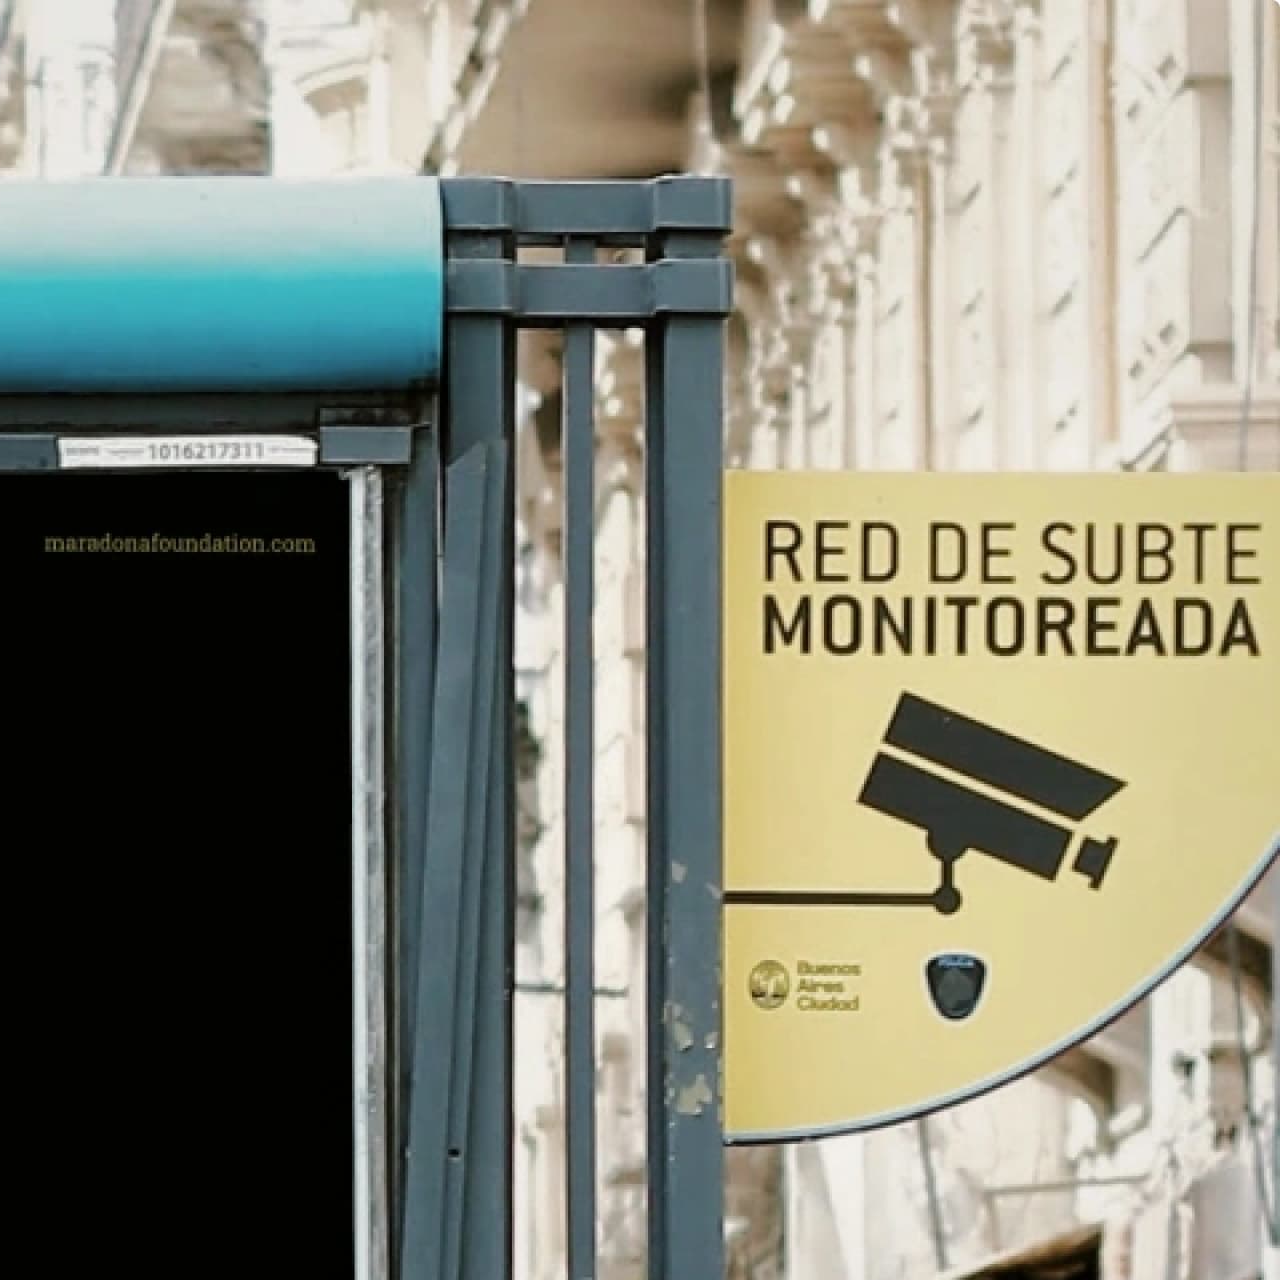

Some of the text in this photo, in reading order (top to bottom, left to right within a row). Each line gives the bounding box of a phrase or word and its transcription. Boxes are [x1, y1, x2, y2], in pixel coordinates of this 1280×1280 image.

[43, 532, 317, 554] maradonafoundation.com
[764, 520, 1261, 585] RED DE SUBTE
[763, 594, 1260, 657] MONITOREADA
[796, 960, 862, 977] Buenos
[796, 978, 845, 993] Aires
[796, 995, 860, 1011] Ciudad
